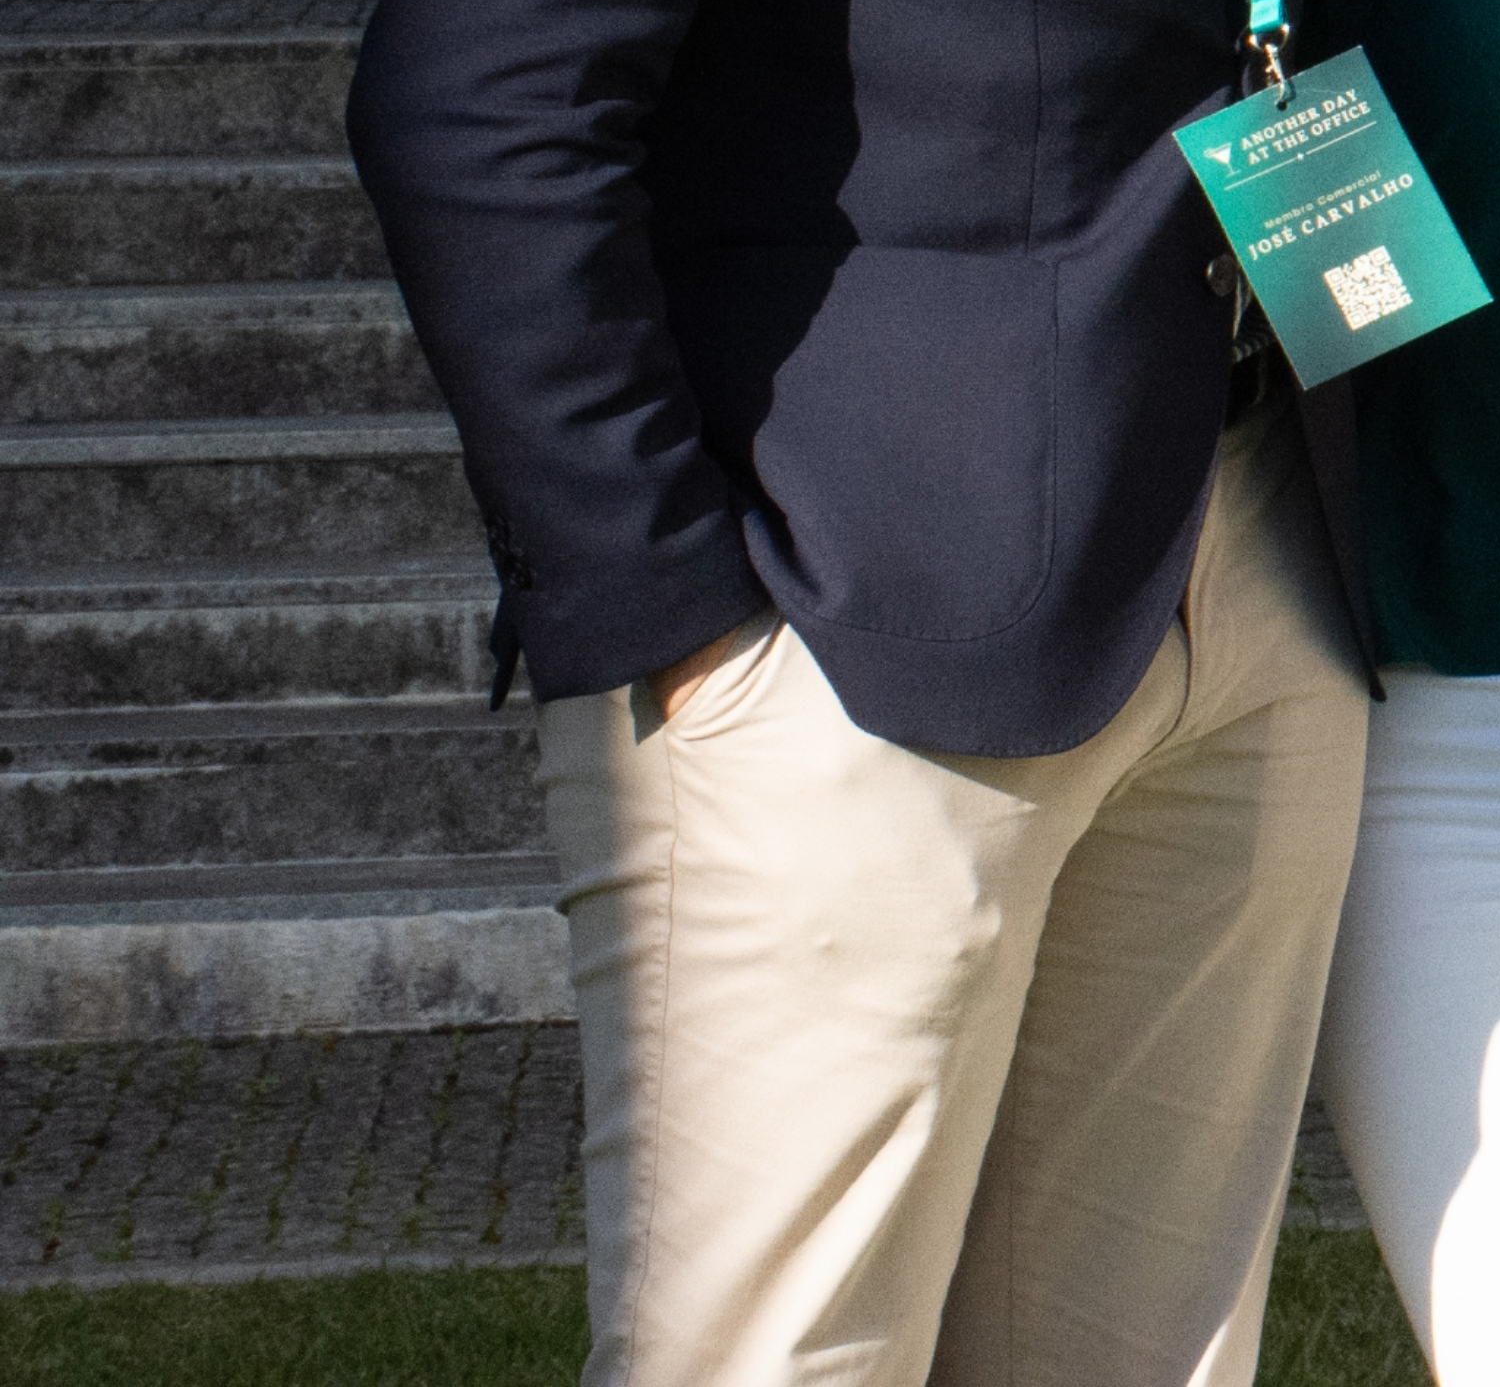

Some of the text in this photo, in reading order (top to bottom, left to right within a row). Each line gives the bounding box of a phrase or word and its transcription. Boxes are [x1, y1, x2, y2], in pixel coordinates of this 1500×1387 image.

[1240, 88, 1359, 152] ANOTHER DAY
[1247, 101, 1371, 166] AT THE OFFICE
[1248, 172, 1415, 261] JOSÉ CARVALHO
